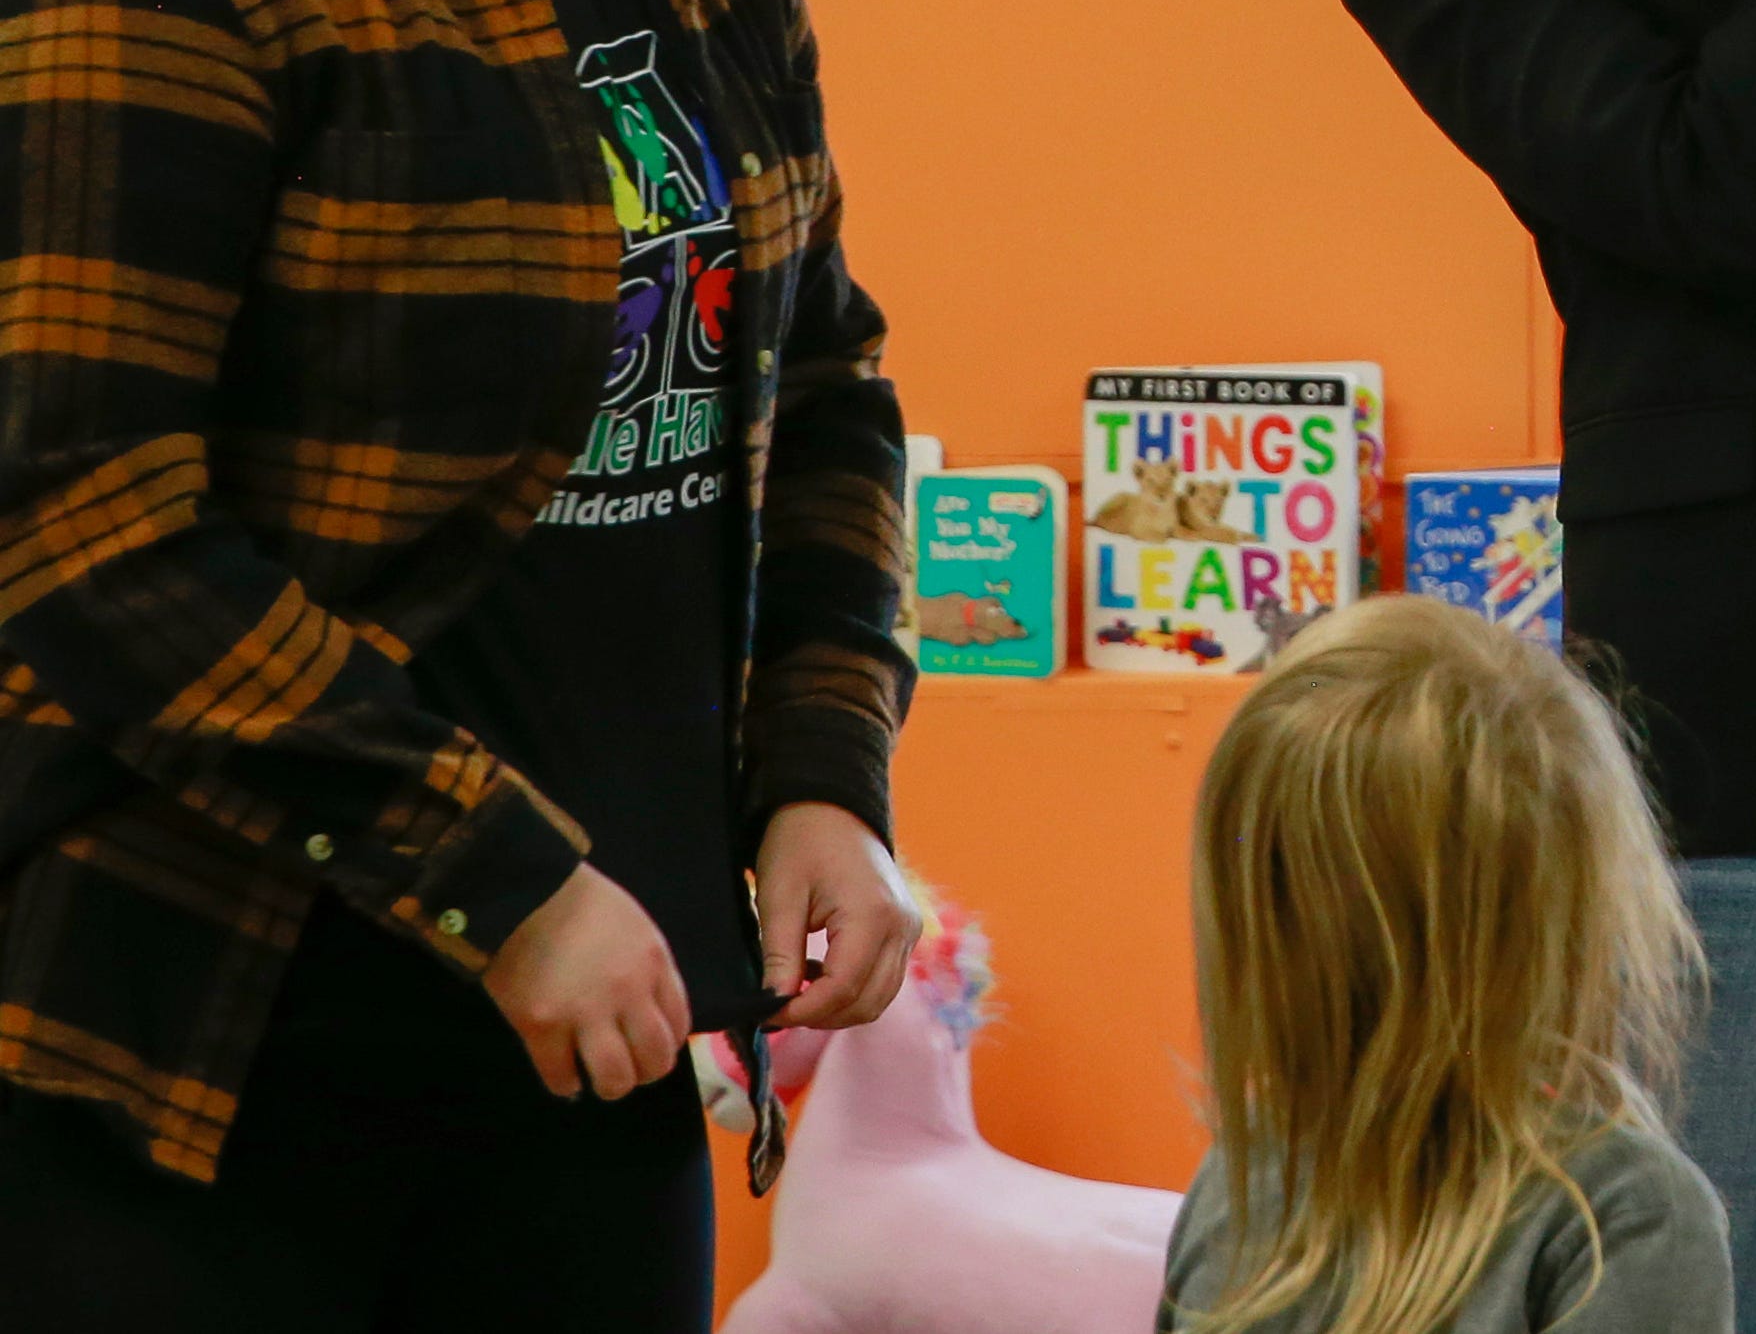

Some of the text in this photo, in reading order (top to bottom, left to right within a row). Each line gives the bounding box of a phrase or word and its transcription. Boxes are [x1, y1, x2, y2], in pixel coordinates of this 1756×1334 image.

[1094, 377, 1336, 403] MY FIRST BOOK OF
[567, 409, 640, 475] le
[1238, 480, 1335, 543] TO
[1097, 544, 1337, 614] LEARN
